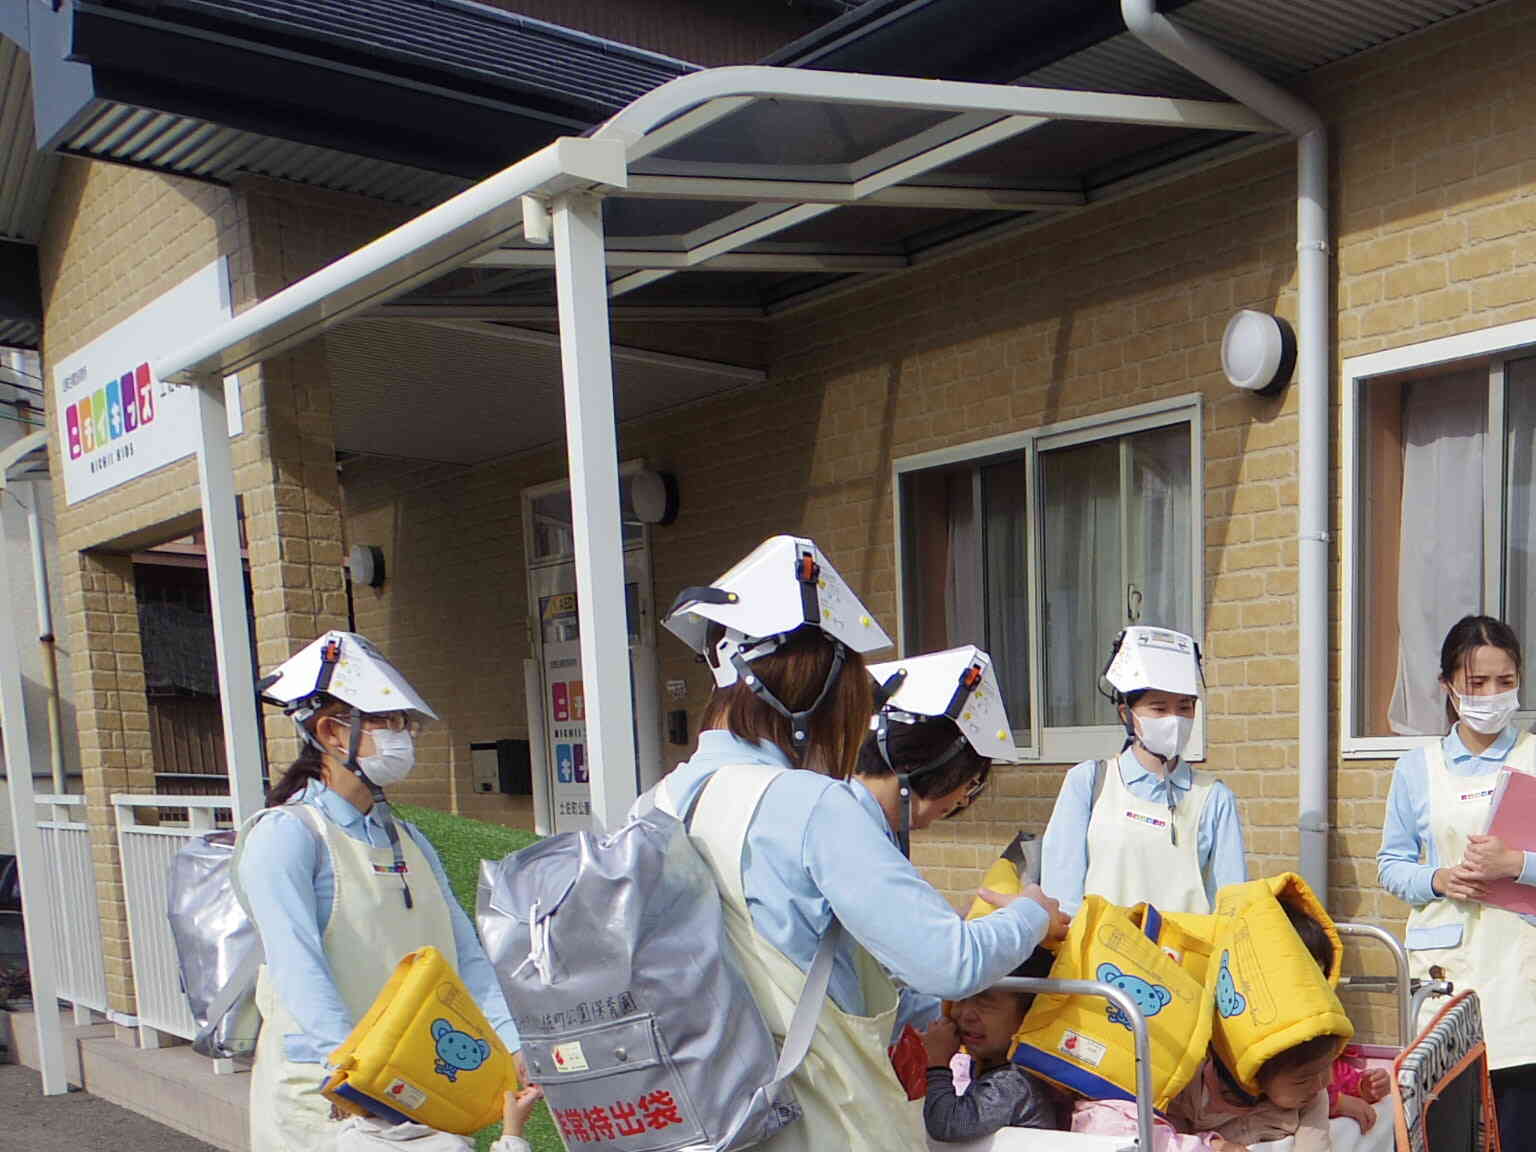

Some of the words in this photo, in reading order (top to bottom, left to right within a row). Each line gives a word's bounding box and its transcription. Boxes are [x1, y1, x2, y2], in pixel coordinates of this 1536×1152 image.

[67, 374, 154, 459] ニチイキッズ
